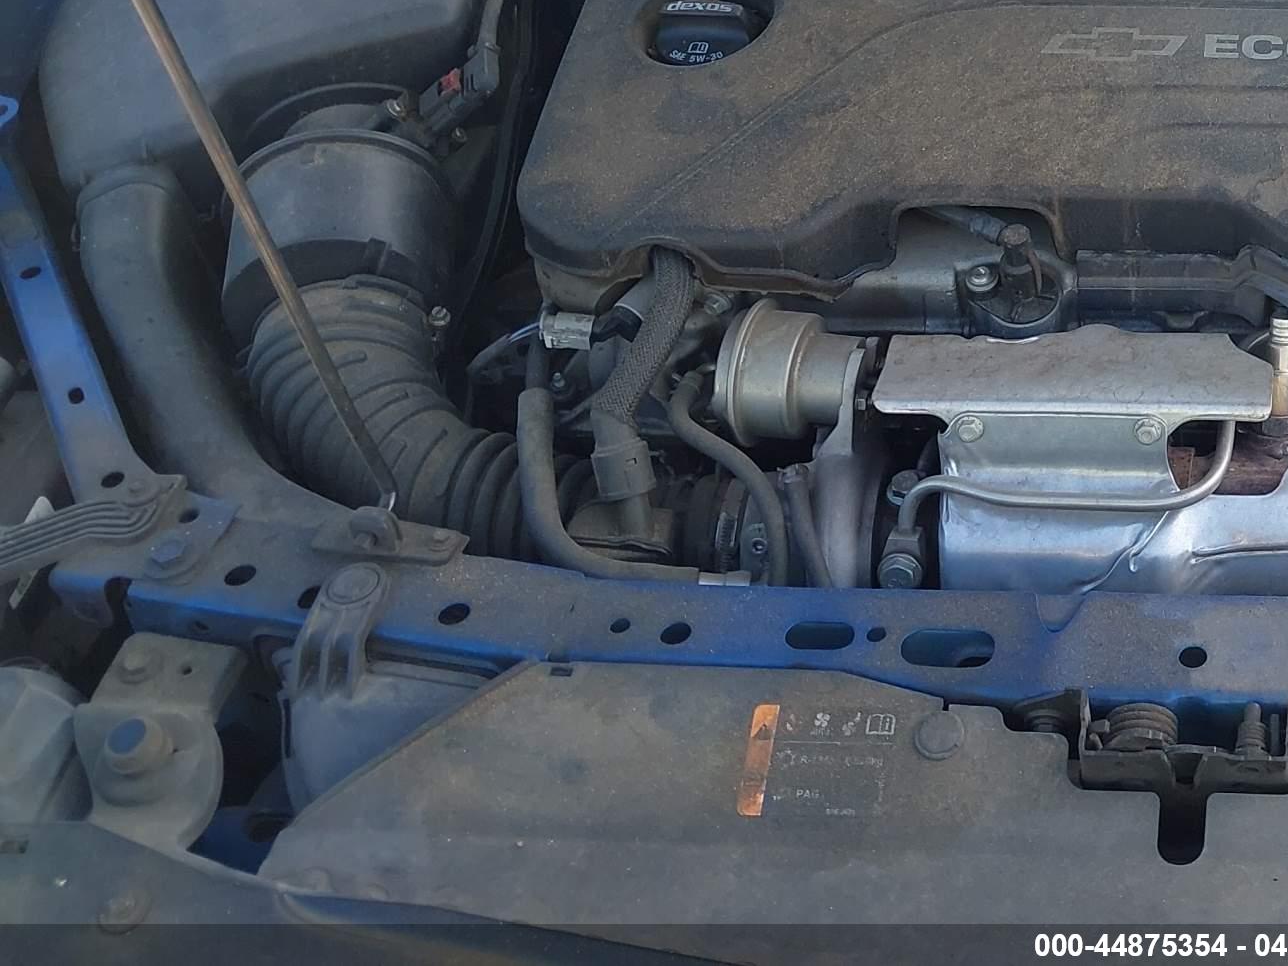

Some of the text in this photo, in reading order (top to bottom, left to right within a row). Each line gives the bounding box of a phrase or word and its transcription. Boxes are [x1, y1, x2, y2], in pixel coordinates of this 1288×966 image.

[666, 0, 732, 13] dexos
[669, 49, 724, 63] SAE 5W-30
